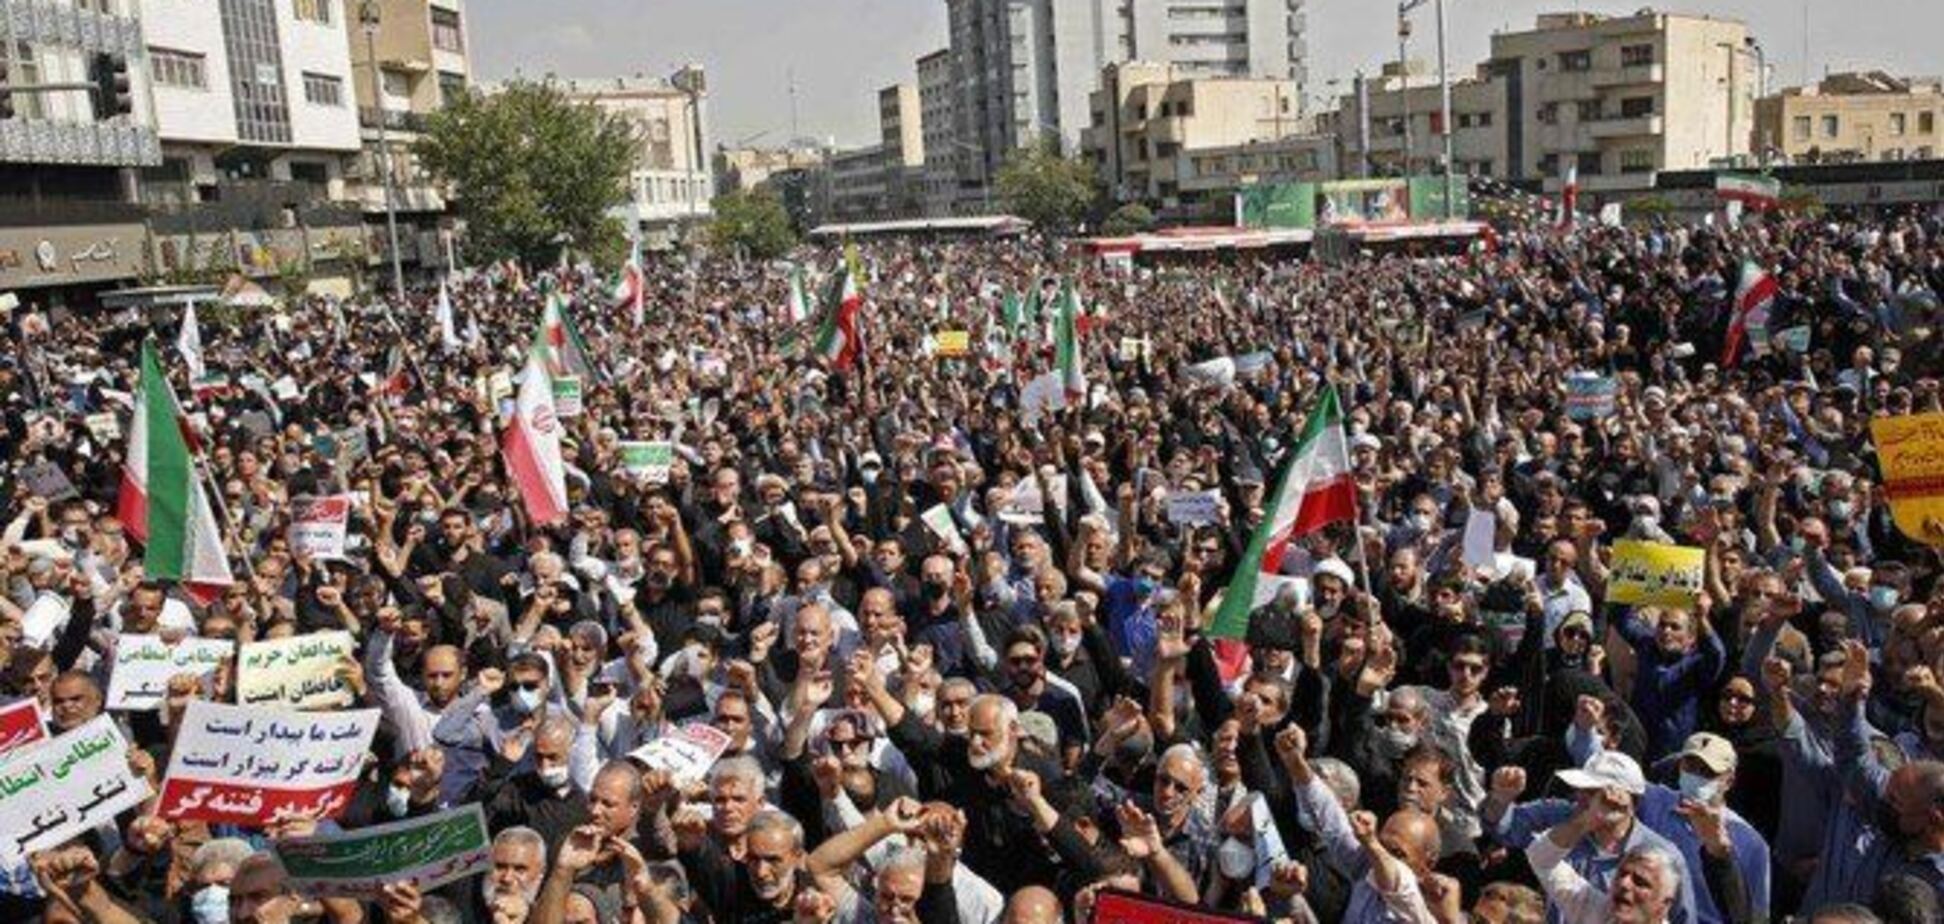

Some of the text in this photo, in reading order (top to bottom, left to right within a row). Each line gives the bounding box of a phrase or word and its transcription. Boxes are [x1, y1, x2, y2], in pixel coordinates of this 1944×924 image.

[205, 719, 363, 744] ملت ما بیدار است
[52, 729, 116, 779] انتظامی
[182, 750, 231, 769] است
[231, 755, 281, 779] بیزار
[16, 774, 126, 853] تشکر تشکر
